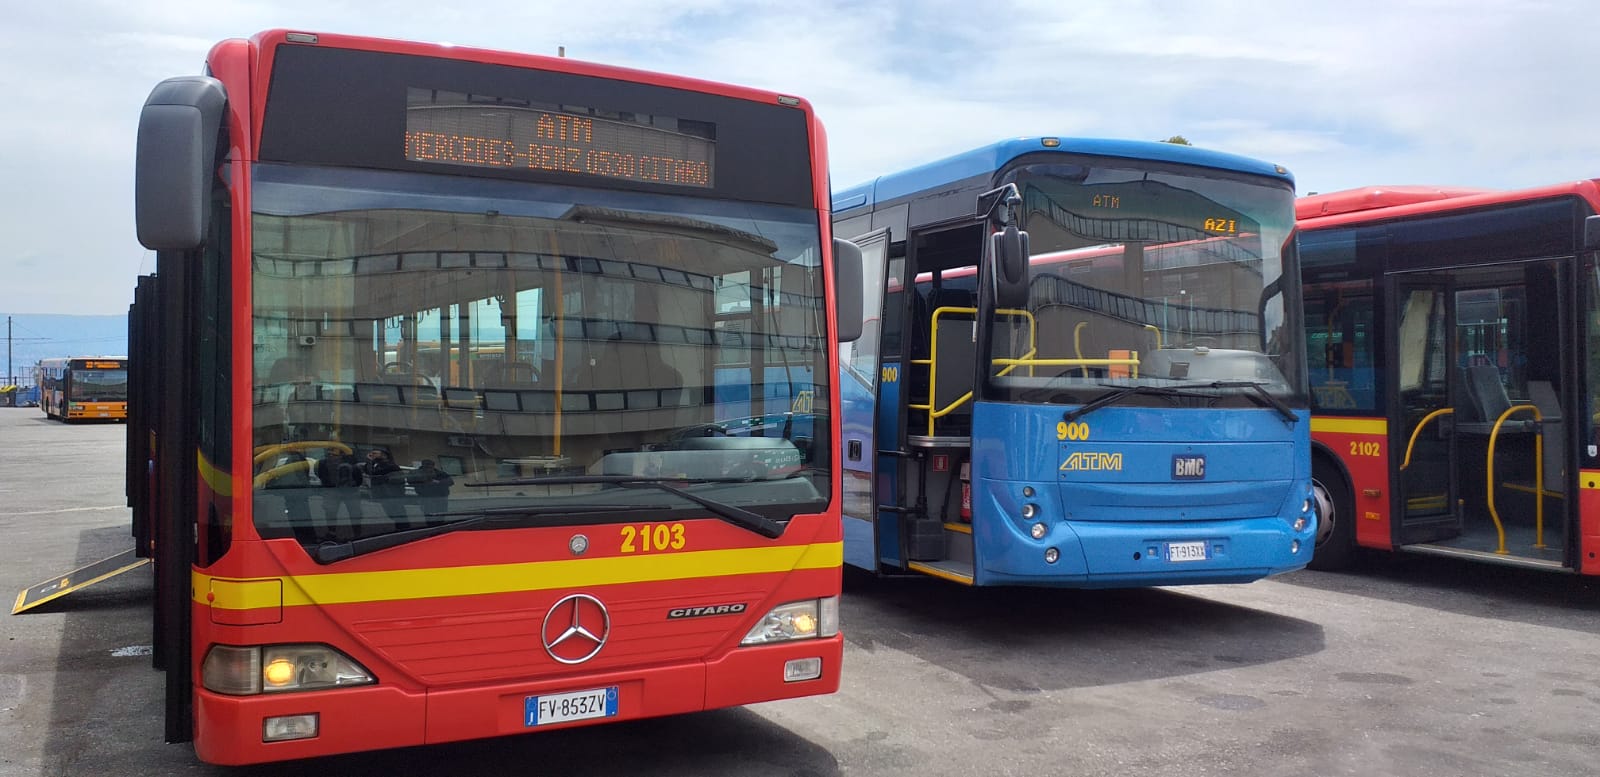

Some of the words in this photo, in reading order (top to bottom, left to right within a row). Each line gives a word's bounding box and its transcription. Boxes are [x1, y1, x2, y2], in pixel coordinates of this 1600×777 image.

[537, 112, 592, 144] ATM
[404, 130, 582, 173] MERCEDES-BENZ
[639, 155, 708, 185] CITARO
[1092, 194, 1120, 209] ATM
[1204, 218, 1237, 233] AZI
[882, 366, 898, 382] 900
[1056, 421, 1089, 441] 900
[1349, 441, 1380, 457] 2102
[1059, 452, 1123, 470] ATM
[1175, 457, 1205, 477] BMC
[620, 523, 686, 553] 2103
[669, 603, 746, 618] CITARO
